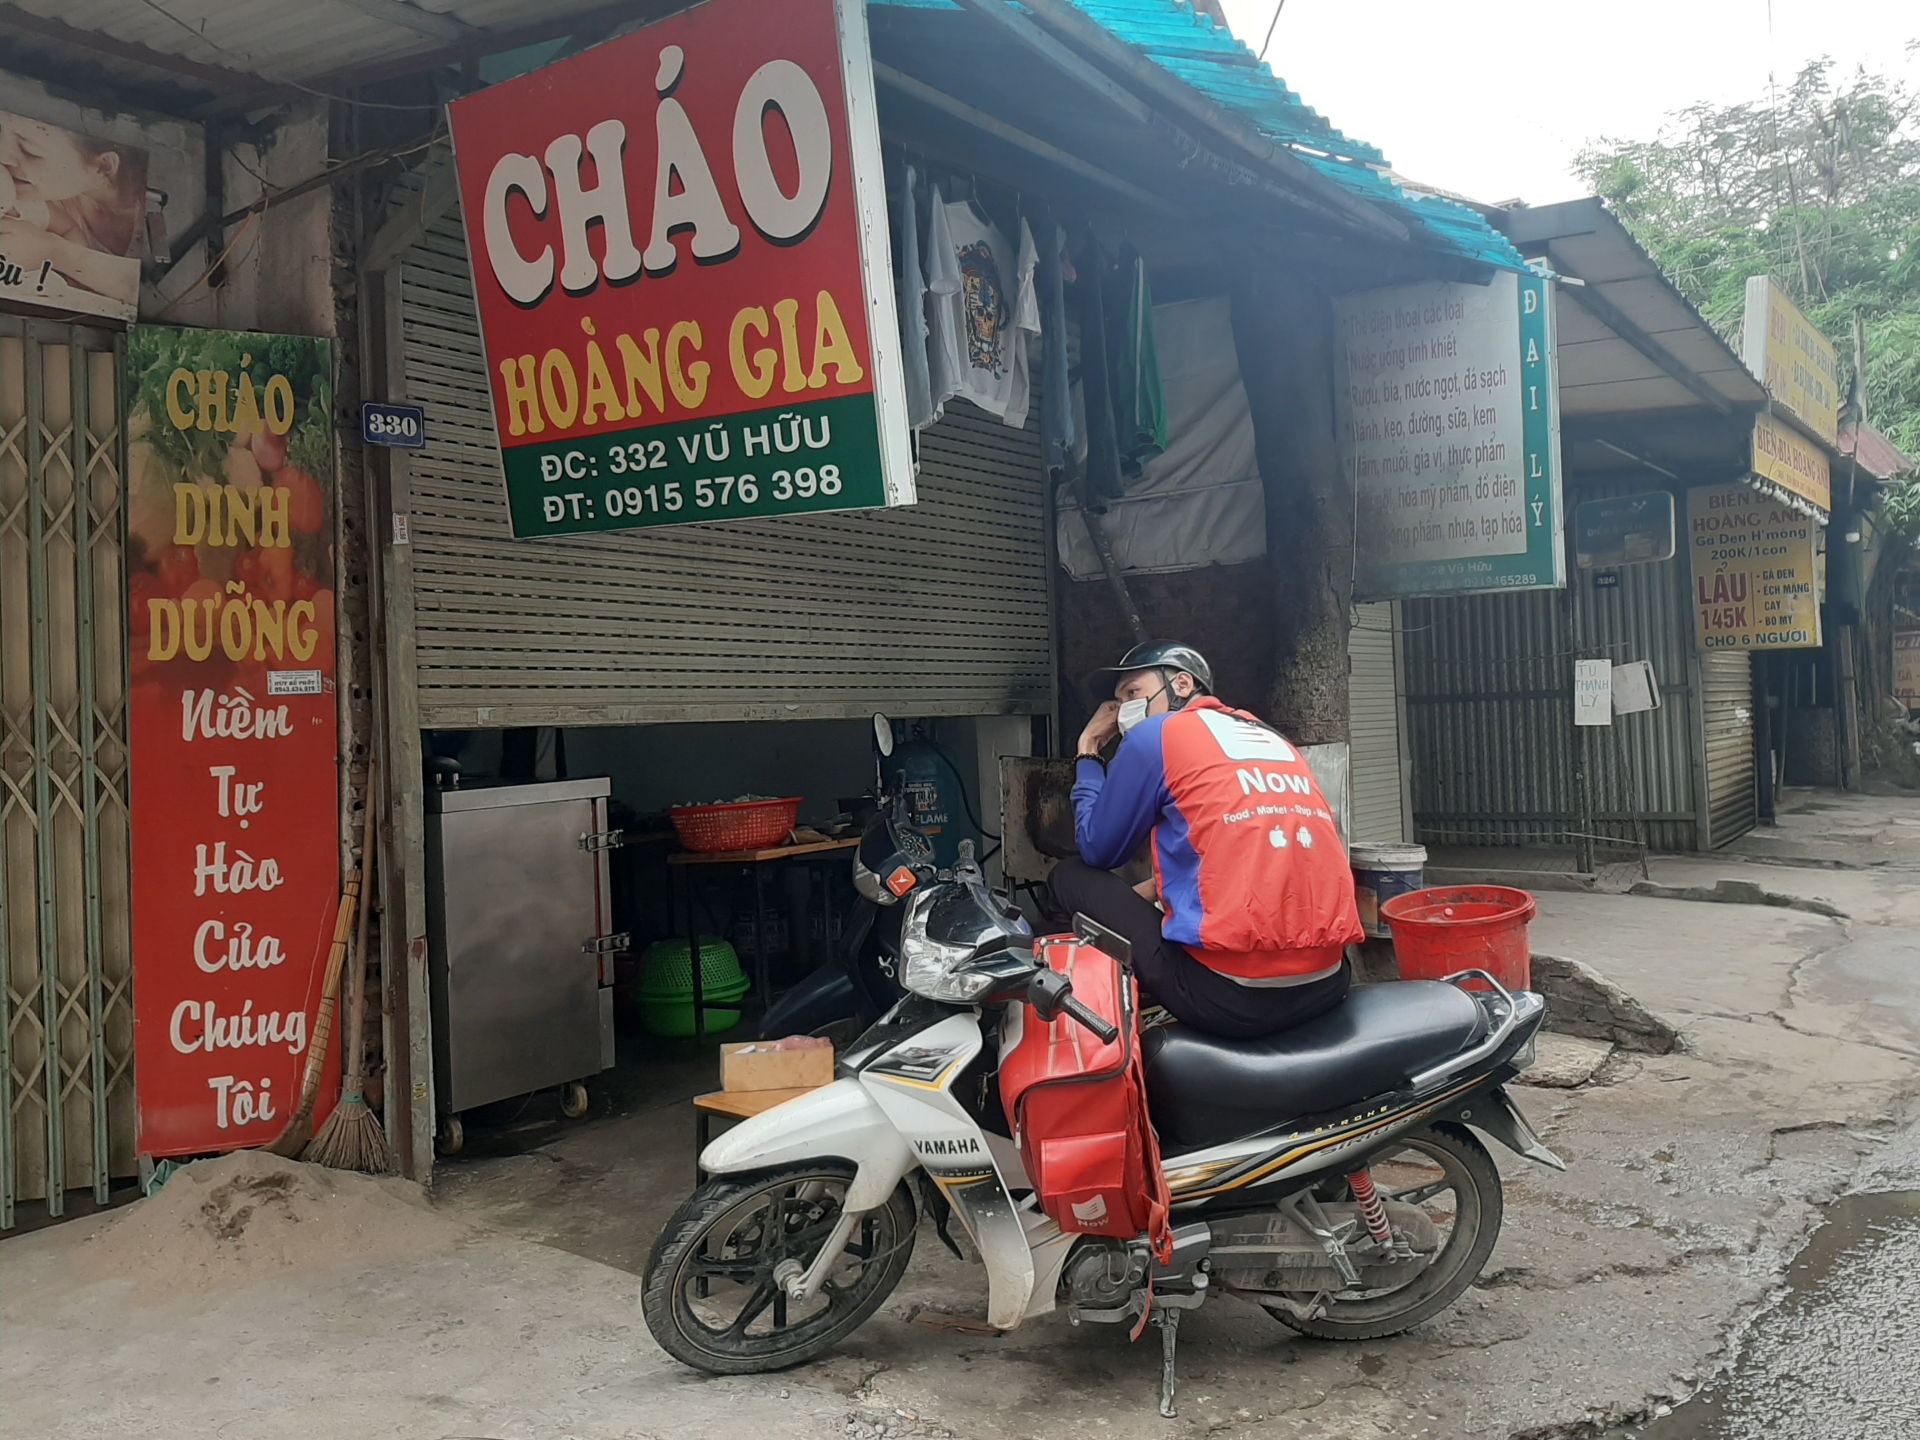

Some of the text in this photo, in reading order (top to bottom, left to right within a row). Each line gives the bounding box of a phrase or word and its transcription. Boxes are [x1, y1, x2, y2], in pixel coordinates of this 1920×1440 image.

[484, 45, 831, 303] CHÁO
[1395, 304, 1420, 332] thoại
[1423, 301, 1442, 325] các
[1445, 297, 1464, 326] loại
[500, 290, 864, 437] HOÀNG GIA
[1380, 340, 1405, 370] uống
[1431, 330, 1457, 359] khiết
[166, 353, 294, 435] CHÁO
[1383, 380, 1402, 404] bia,
[1405, 374, 1431, 399] nước
[1434, 372, 1460, 400] ngọt,
[1463, 367, 1477, 391] đá
[1480, 363, 1506, 395] sạch
[369, 413, 417, 437] 330
[1384, 417, 1406, 443] kẹo,
[1408, 411, 1445, 438] đường,
[1448, 406, 1470, 432] sữa,
[1473, 404, 1496, 426] kem
[540, 412, 831, 483] ĐC: 332 VŨ HỮU
[1382, 446, 1411, 473] muối,
[1414, 448, 1430, 476] gia
[1433, 445, 1445, 473] vị,
[1448, 443, 1472, 470] thực
[1475, 431, 1506, 468] phẩm
[1779, 438, 1792, 467] BIA
[543, 465, 842, 523] ĐT: 0915 576 398
[1399, 485, 1418, 508] hóa
[1420, 483, 1437, 510] mỹ
[1440, 472, 1472, 508] phẩm,
[1475, 475, 1489, 499] đồ
[1492, 473, 1516, 504] điện
[174, 483, 291, 548] DINH
[1448, 517, 1478, 543] nhựa,
[1481, 514, 1499, 541] tạp
[1501, 511, 1522, 534] hóa
[1768, 509, 1808, 524] ANH
[1698, 561, 1747, 605] LẨU
[147, 581, 319, 661] DƯỠNG
[1701, 607, 1747, 629] 145K
[1764, 600, 1781, 611] CAY
[1704, 628, 1807, 648] CHO 6 NGƯỜI
[182, 687, 293, 742] Niềm
[209, 766, 263, 828] Tự
[1236, 767, 1310, 795] Now
[1223, 809, 1250, 825] Food
[1256, 804, 1288, 816] Market
[1294, 804, 1312, 818] Ship
[194, 841, 283, 896] Hào
[193, 920, 285, 973] Của
[170, 1000, 307, 1054] Chúng
[208, 1075, 275, 1129] Tôi
[914, 1138, 981, 1155] YAMAHA
